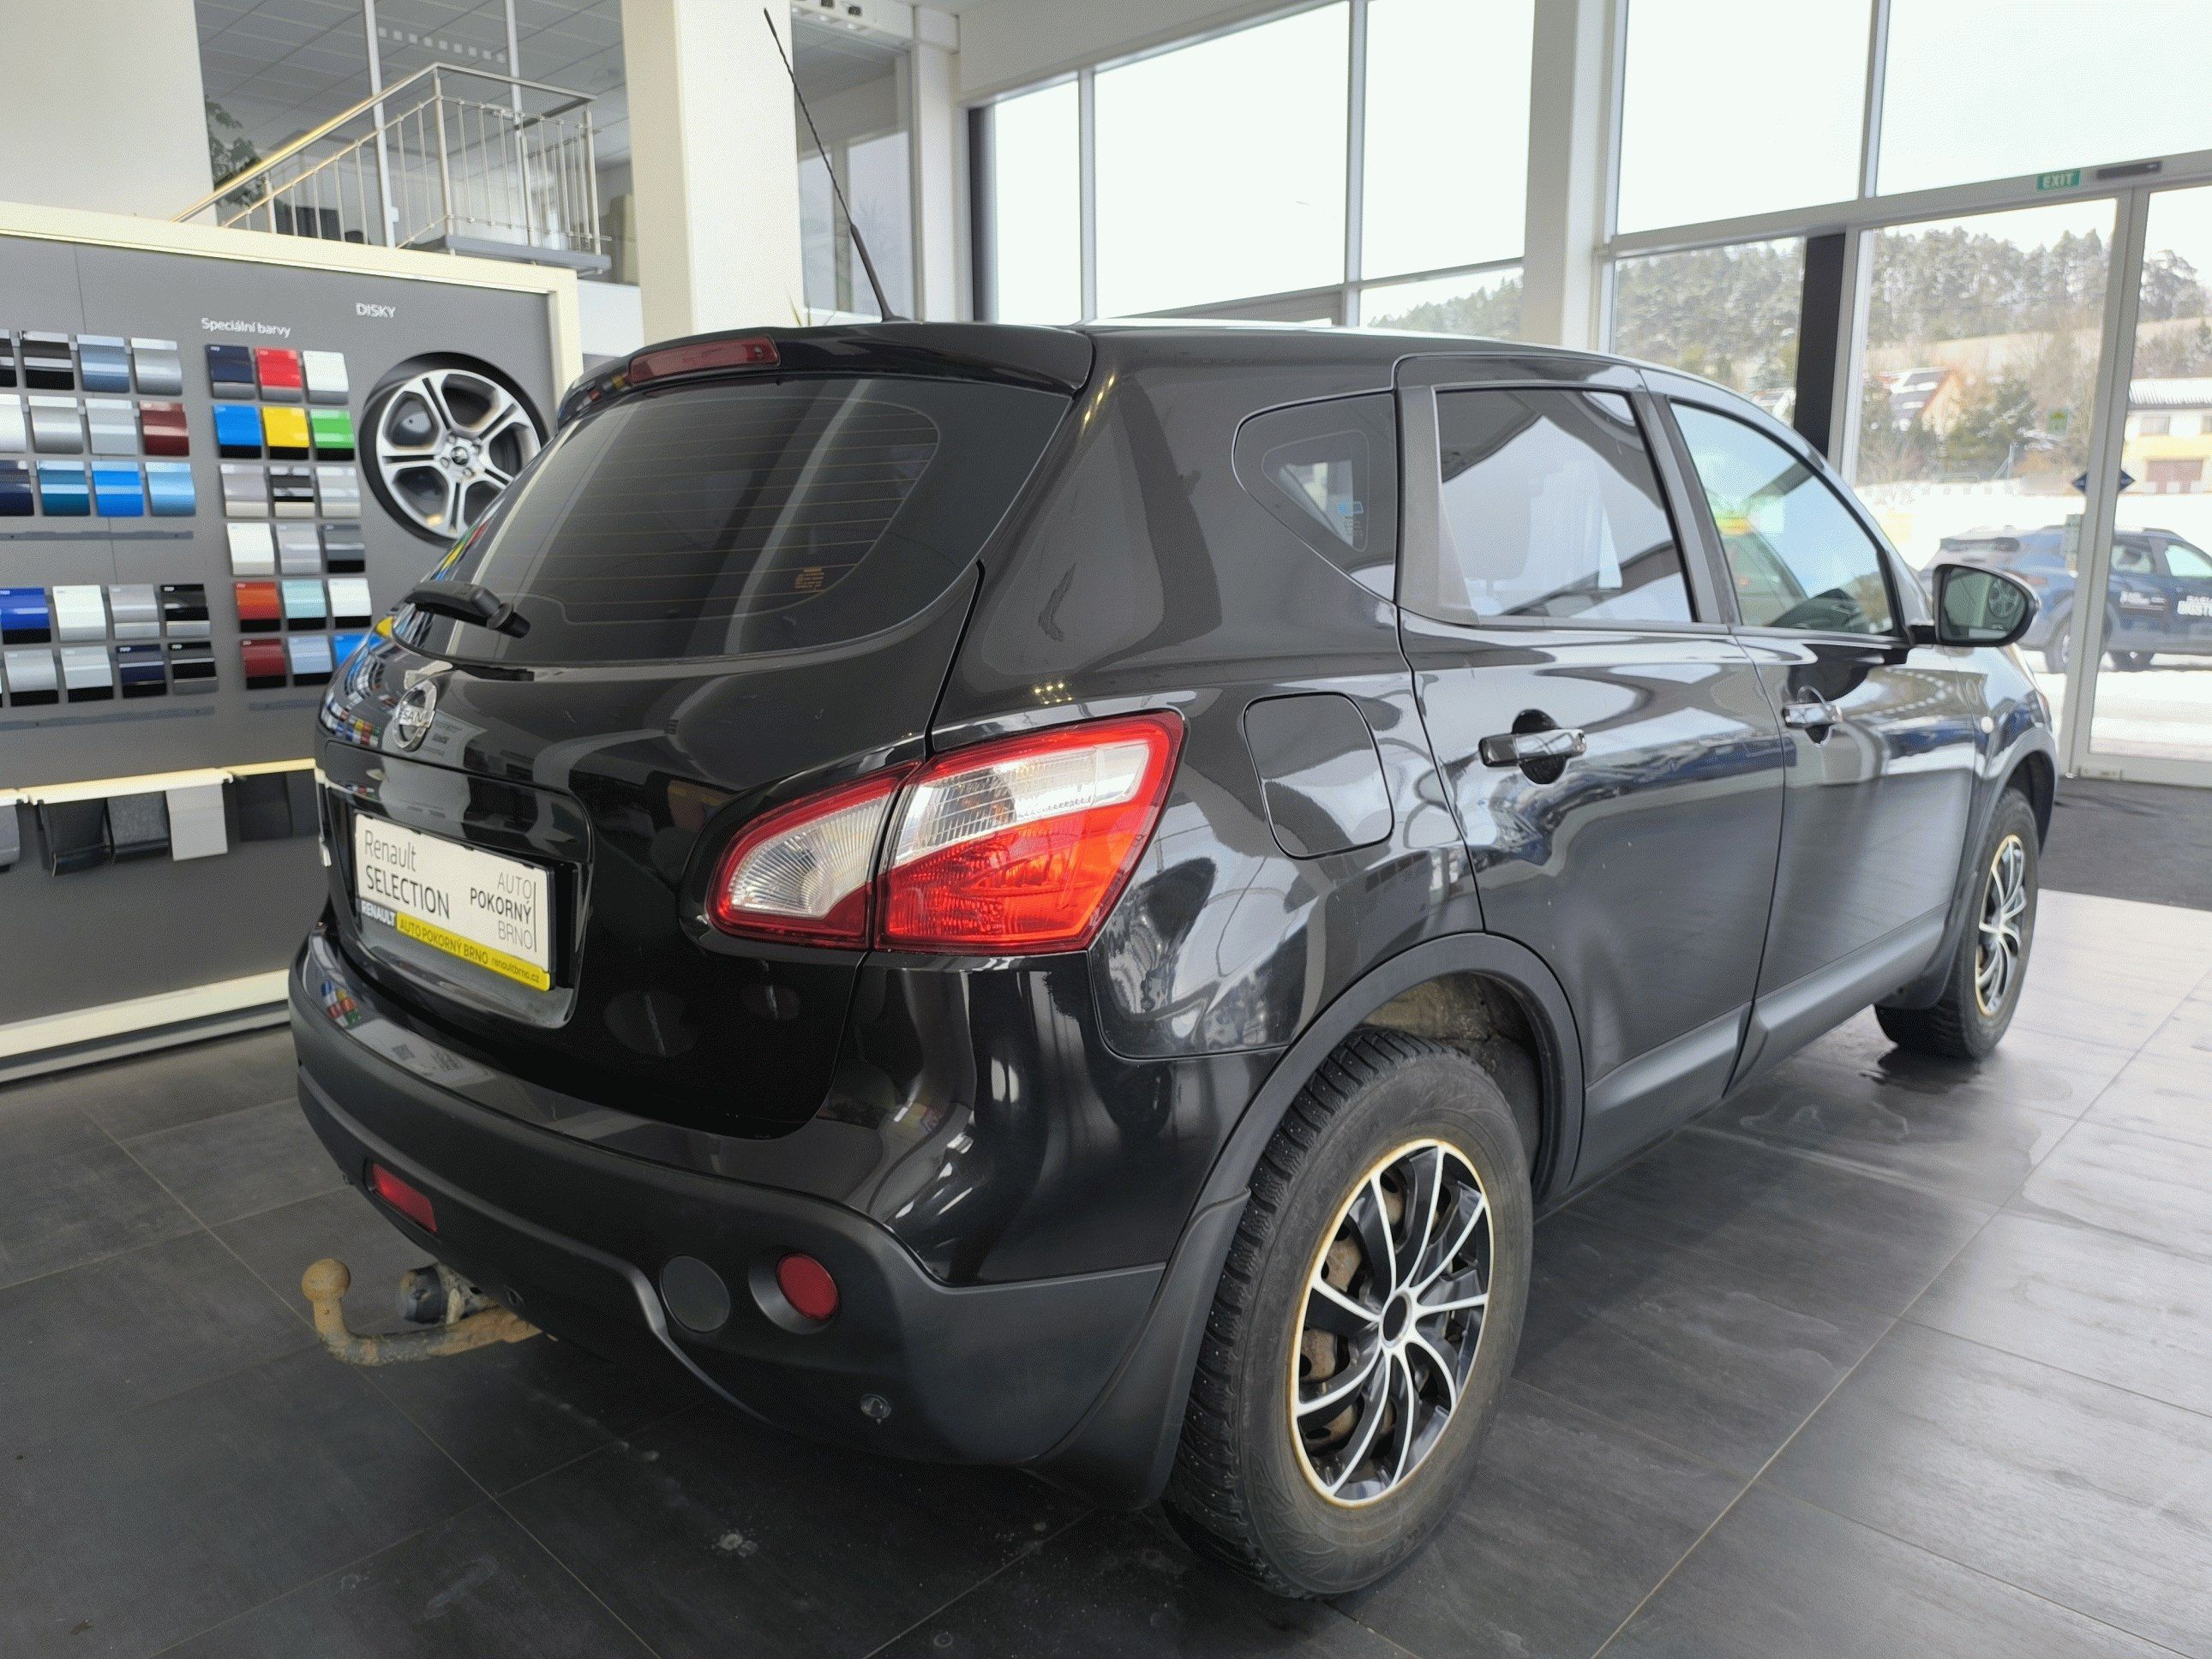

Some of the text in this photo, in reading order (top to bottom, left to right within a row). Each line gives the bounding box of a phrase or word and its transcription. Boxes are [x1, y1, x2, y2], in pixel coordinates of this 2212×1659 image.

[2042, 173, 2073, 189] EXIT
[355, 302, 396, 318] DISKY
[201, 317, 291, 338] Speciální barvy
[364, 830, 417, 872] Renault
[365, 864, 450, 919] SELECTION
[497, 871, 532, 900] AUTO
[361, 900, 396, 926] RENAULT
[470, 886, 532, 925] POKORNÝ
[498, 919, 533, 949] BRNO
[399, 918, 422, 938] AUTO
[464, 944, 489, 964] BRNO
[491, 957, 540, 983] renaultbrno.cz
